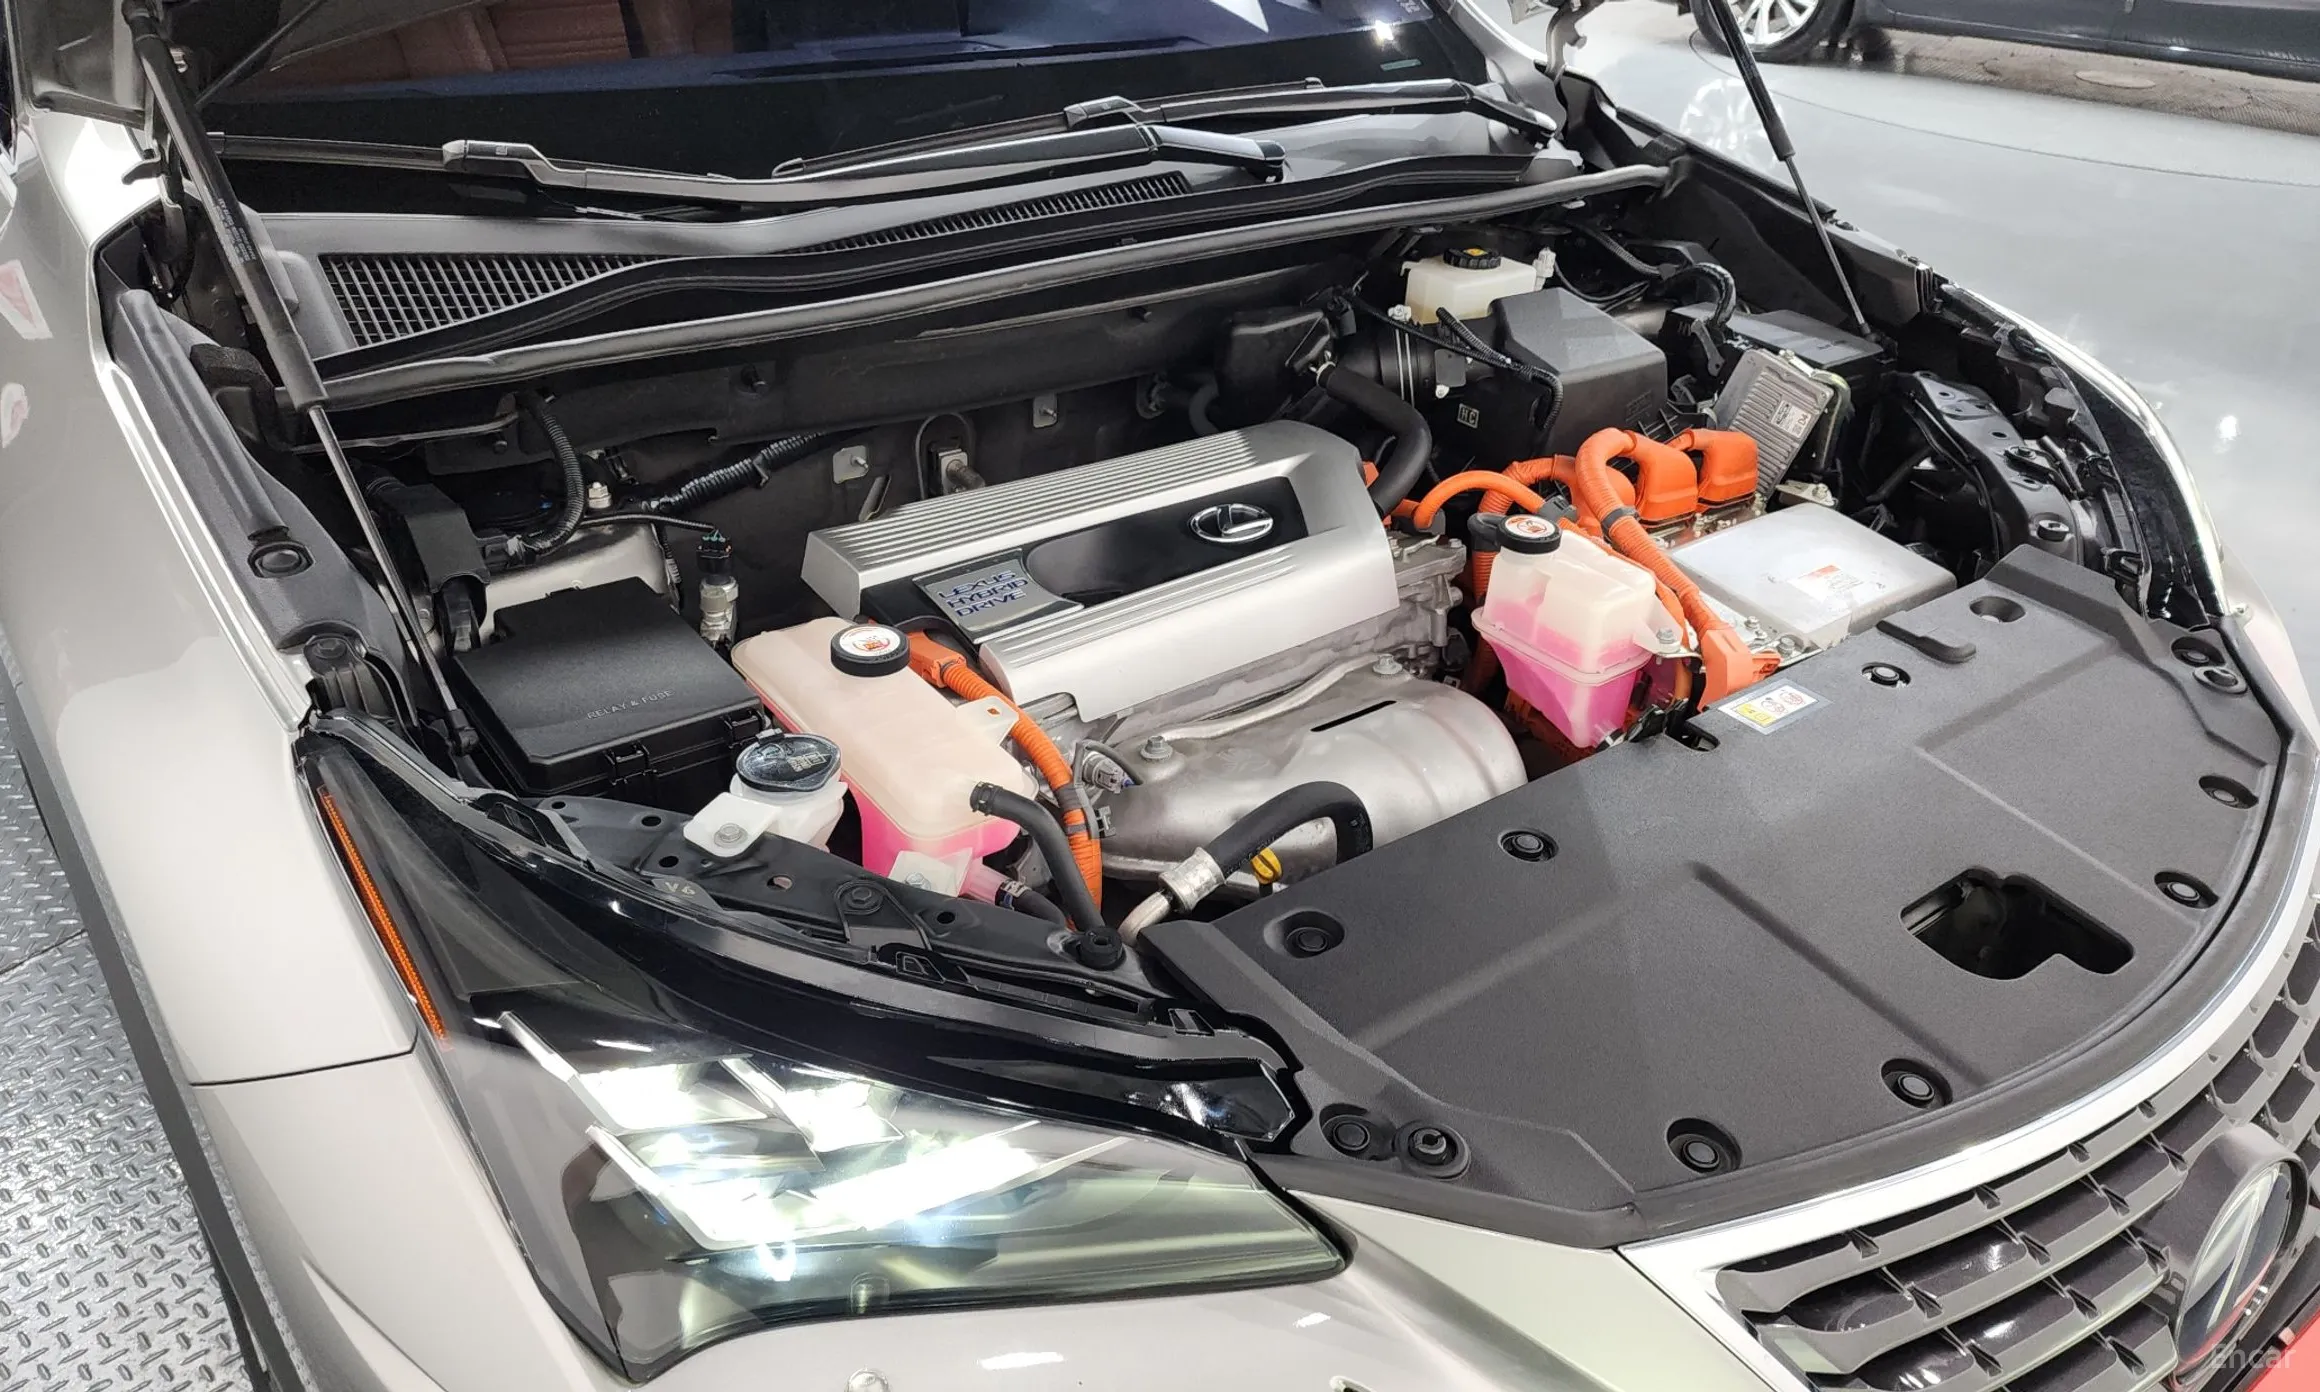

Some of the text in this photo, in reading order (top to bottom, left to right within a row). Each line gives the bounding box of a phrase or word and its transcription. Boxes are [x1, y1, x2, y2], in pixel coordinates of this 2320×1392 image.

[938, 569, 1016, 599] LEXUS
[945, 576, 1029, 609] HYBRID
[954, 588, 1027, 617] DRIVE
[586, 702, 627, 720] RELAY
